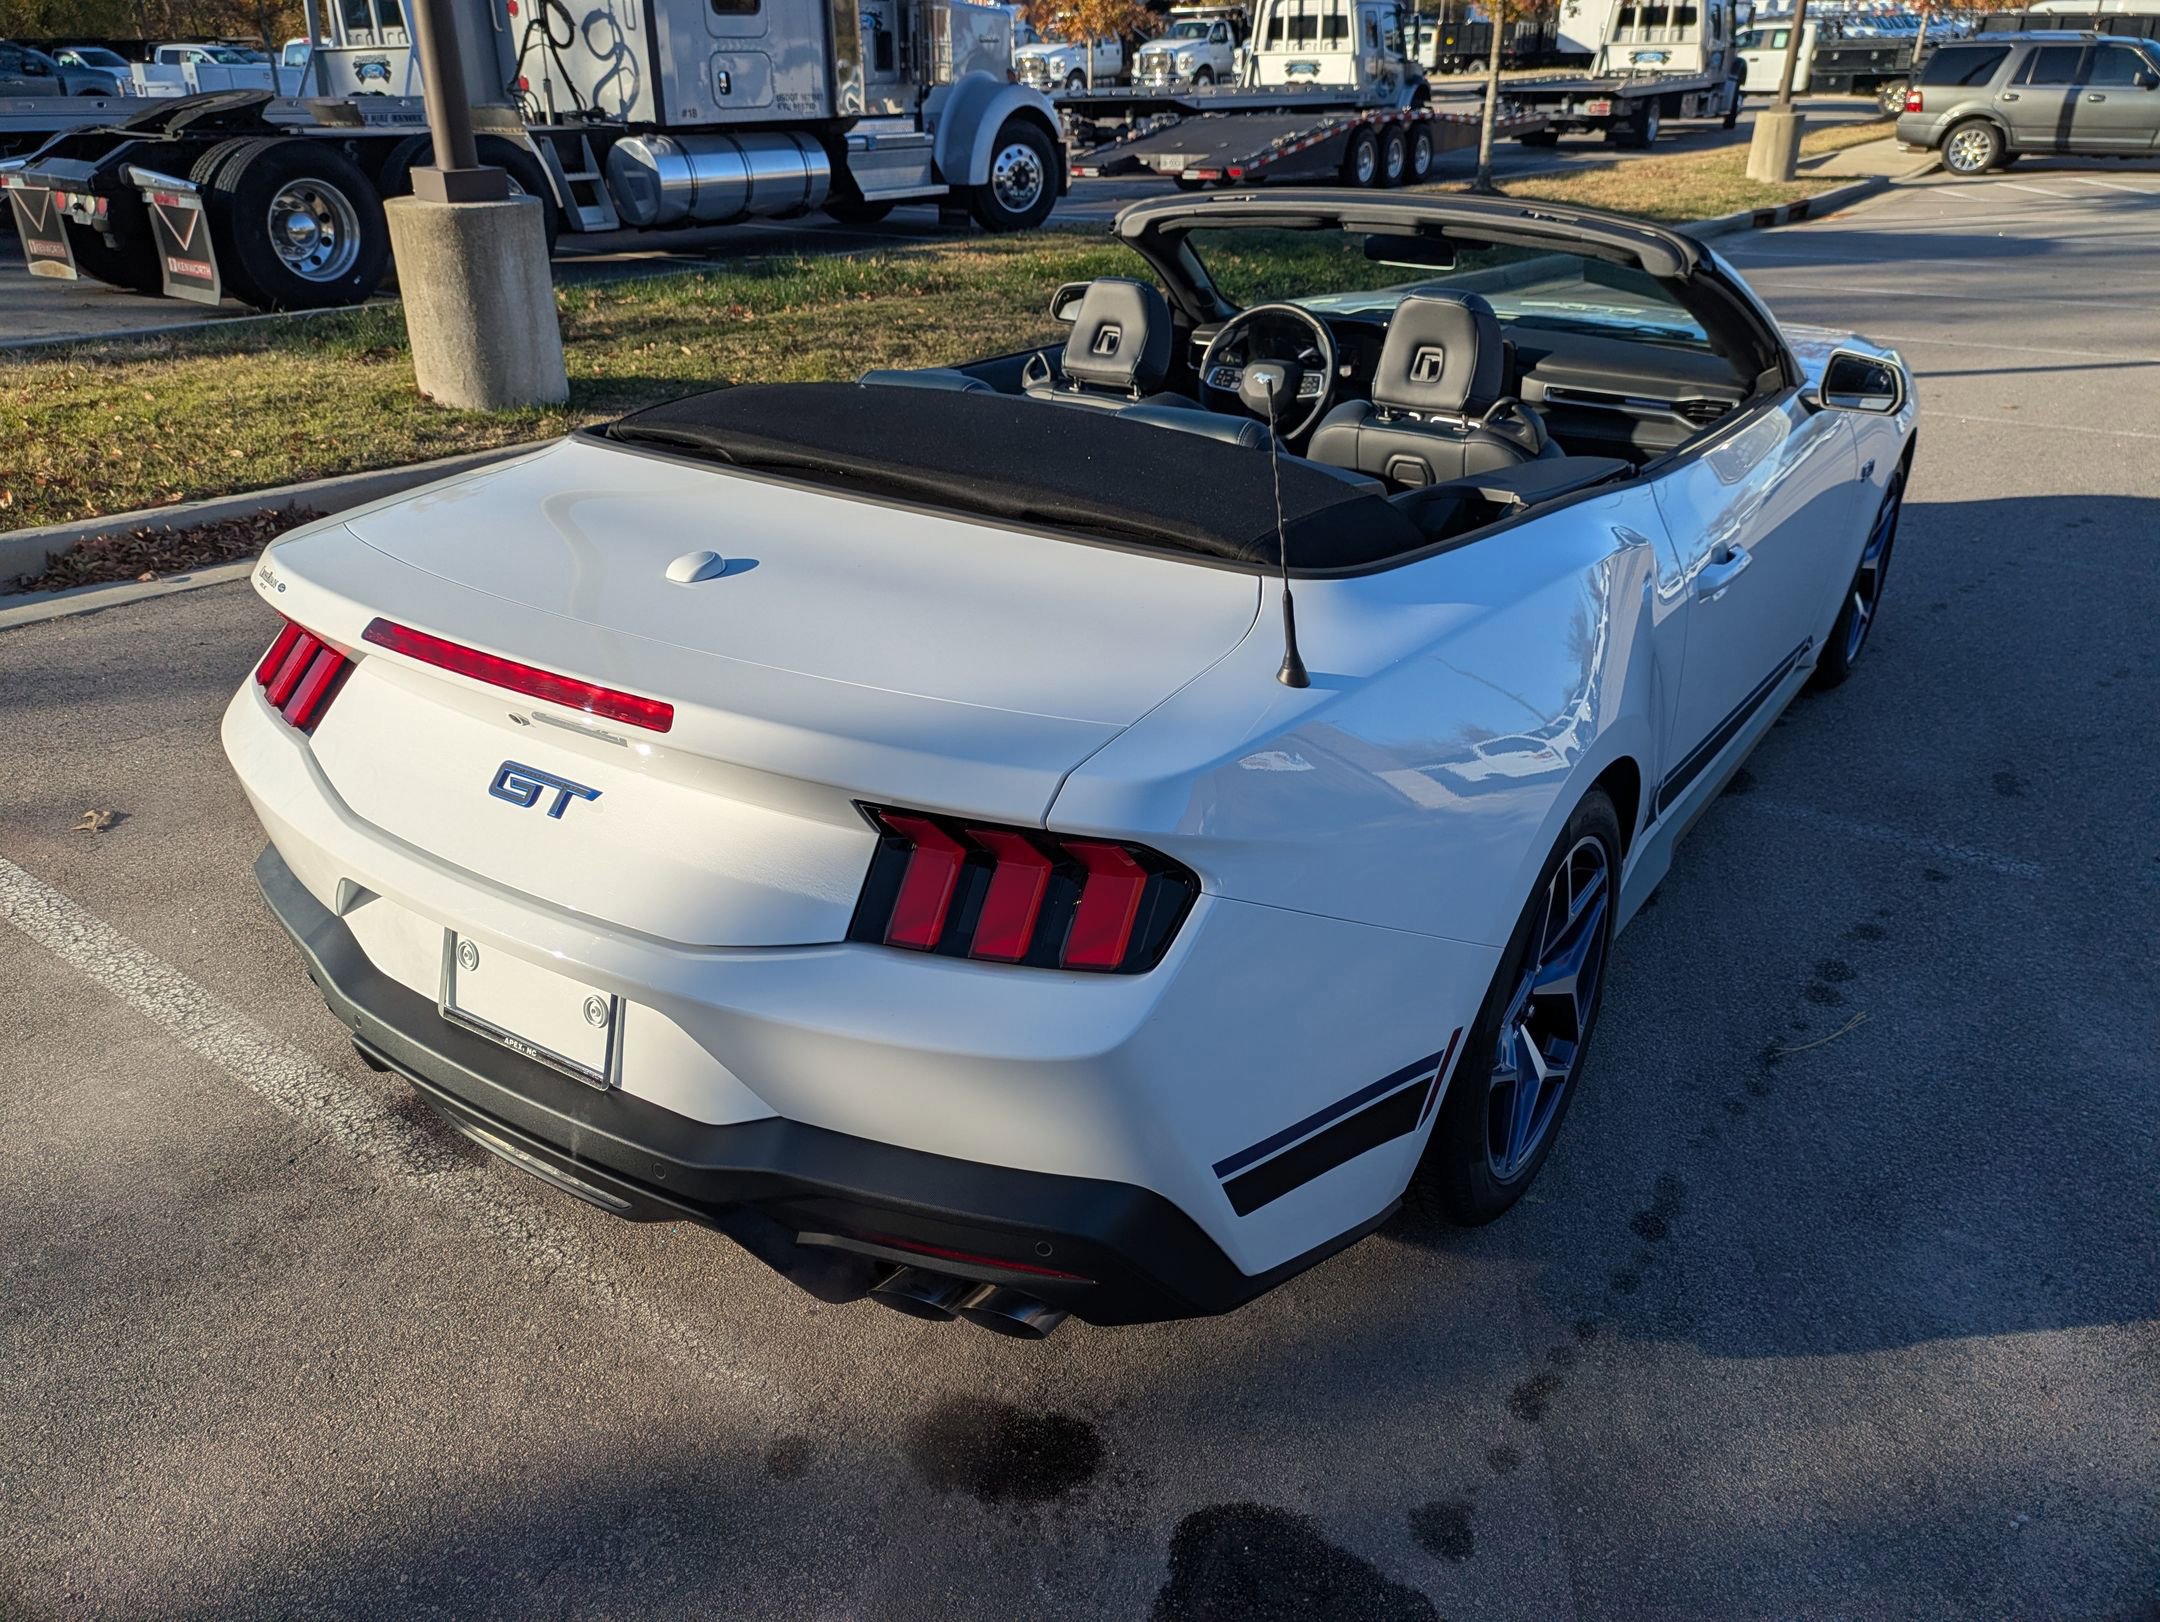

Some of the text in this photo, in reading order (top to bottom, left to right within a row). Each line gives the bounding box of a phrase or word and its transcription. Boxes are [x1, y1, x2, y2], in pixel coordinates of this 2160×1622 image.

[177, 262, 212, 276] KENWORTH
[488, 760, 604, 820] GT
[504, 1037, 537, 1057] APEX, NC
